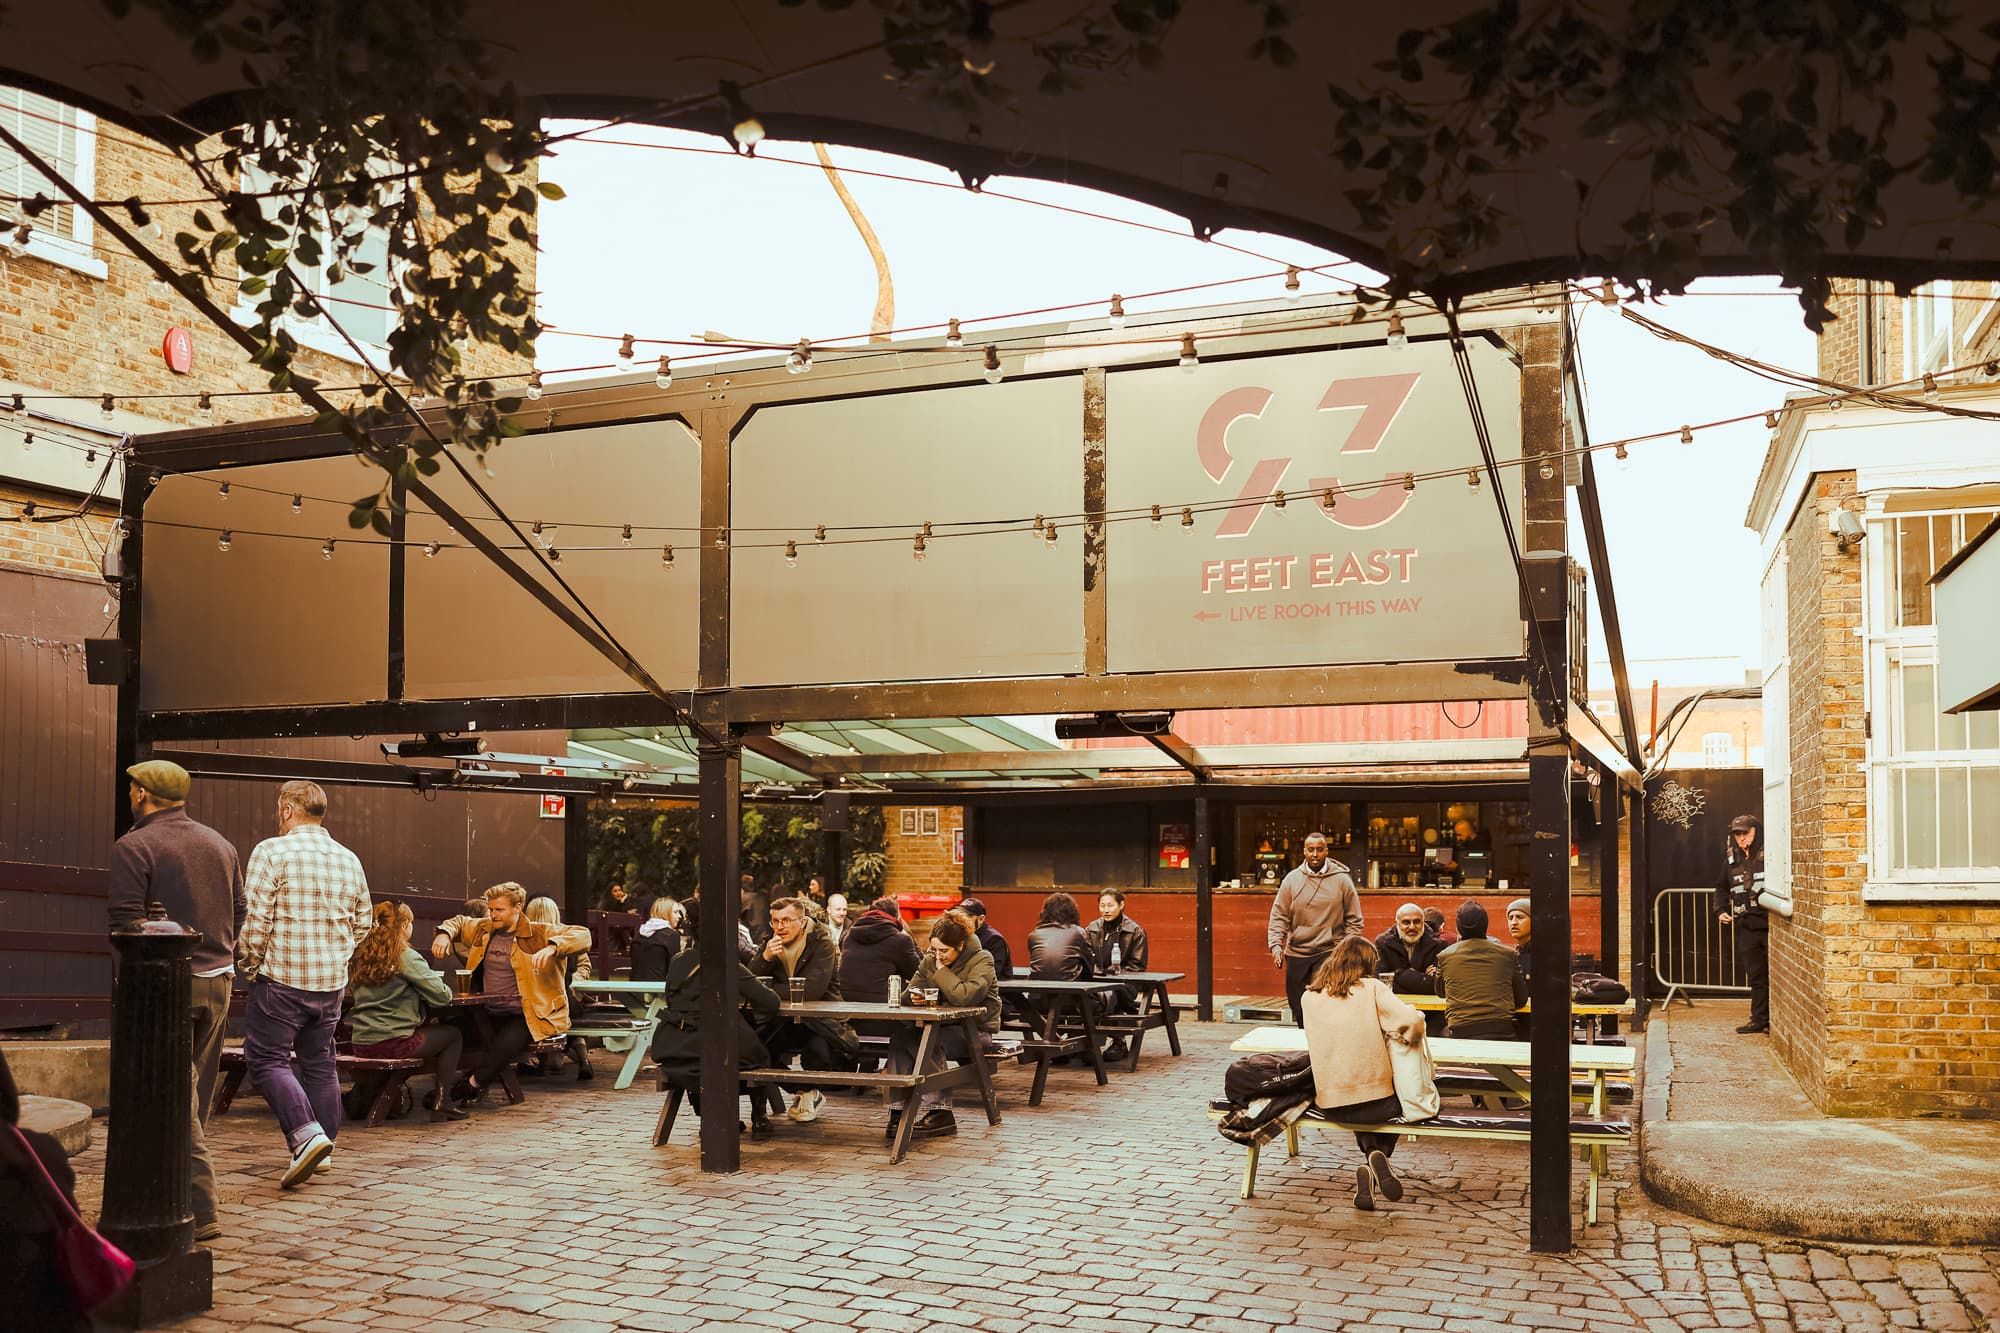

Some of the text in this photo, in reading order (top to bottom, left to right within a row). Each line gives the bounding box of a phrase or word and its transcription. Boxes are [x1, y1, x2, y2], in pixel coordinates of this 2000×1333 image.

[1197, 372, 1421, 540] 93
[1201, 548, 1418, 594] FEET EAST
[1230, 596, 1424, 623] LIVE ROOM THIS WAY
